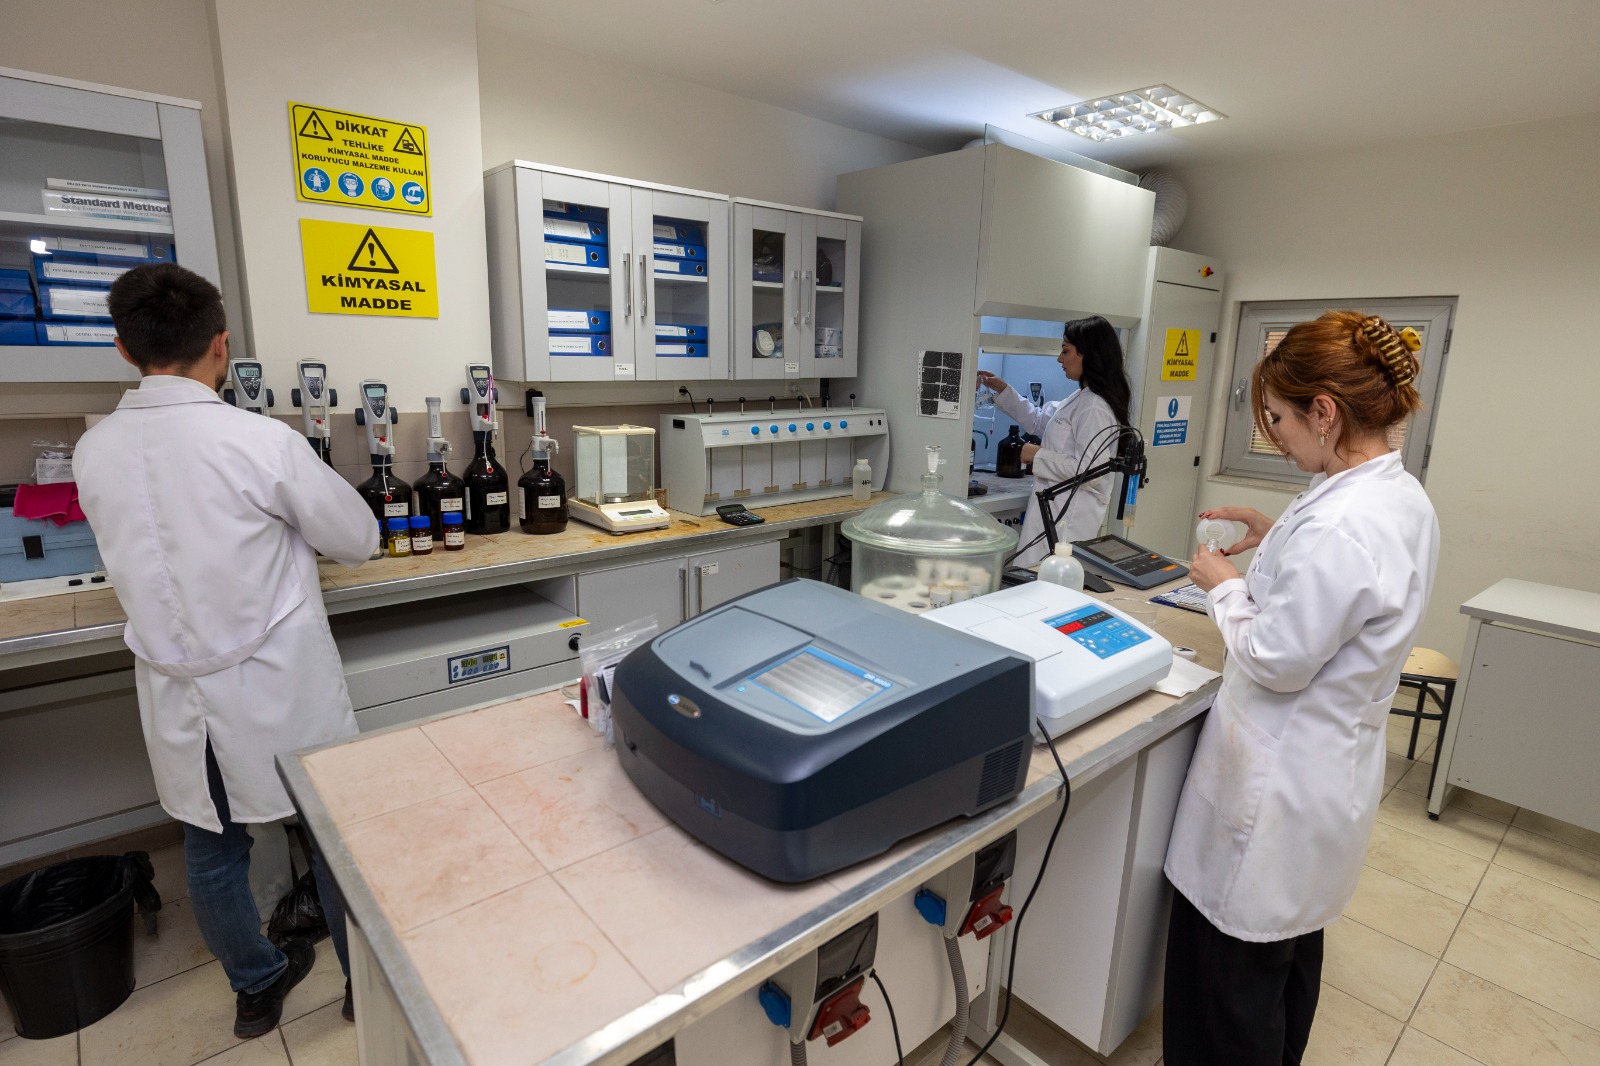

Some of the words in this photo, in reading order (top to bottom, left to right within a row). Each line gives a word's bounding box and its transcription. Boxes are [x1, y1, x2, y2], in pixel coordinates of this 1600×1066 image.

[335, 120, 388, 138] DİKKAT
[342, 139, 384, 152] TEHLİKE
[327, 147, 370, 159] KİMYASAL
[372, 154, 400, 164] MADDE
[301, 152, 350, 165] KORUYUCU
[352, 161, 391, 172] MALZEME
[392, 167, 424, 177] KULLAN
[61, 195, 120, 209] Standard
[123, 201, 171, 213] Method
[321, 273, 426, 293] KİMYASAL
[340, 296, 412, 310] MADDE
[1166, 357, 1194, 366] KİMYASAL
[1169, 370, 1190, 378] MADDE
